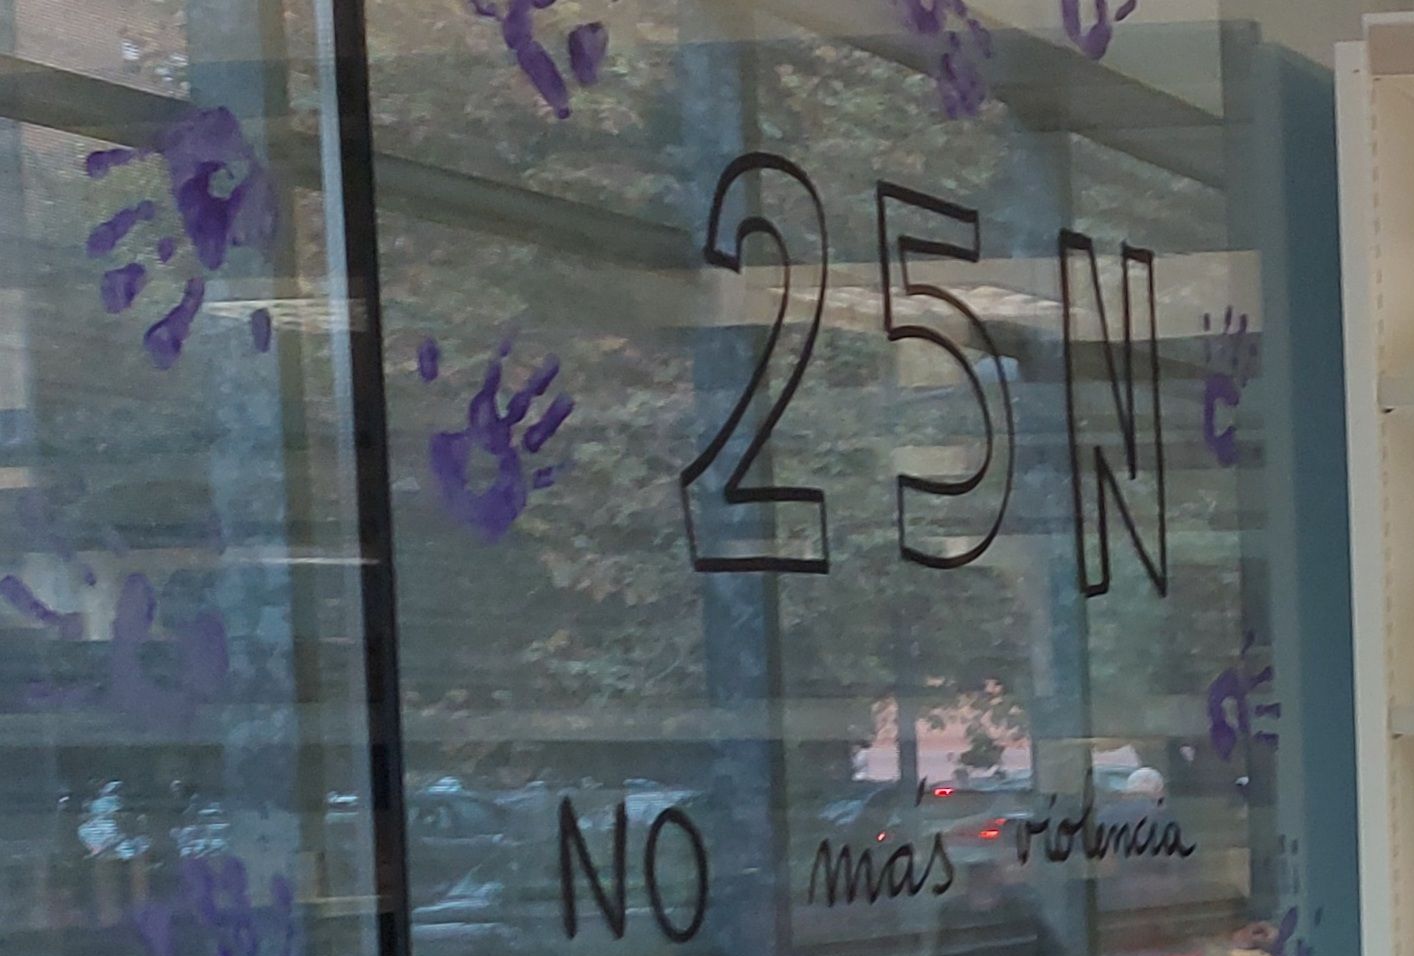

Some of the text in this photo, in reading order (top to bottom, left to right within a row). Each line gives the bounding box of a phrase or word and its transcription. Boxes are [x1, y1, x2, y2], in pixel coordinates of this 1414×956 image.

[680, 150, 1168, 599] 25N
[557, 767, 1199, 944] NO más violencia
